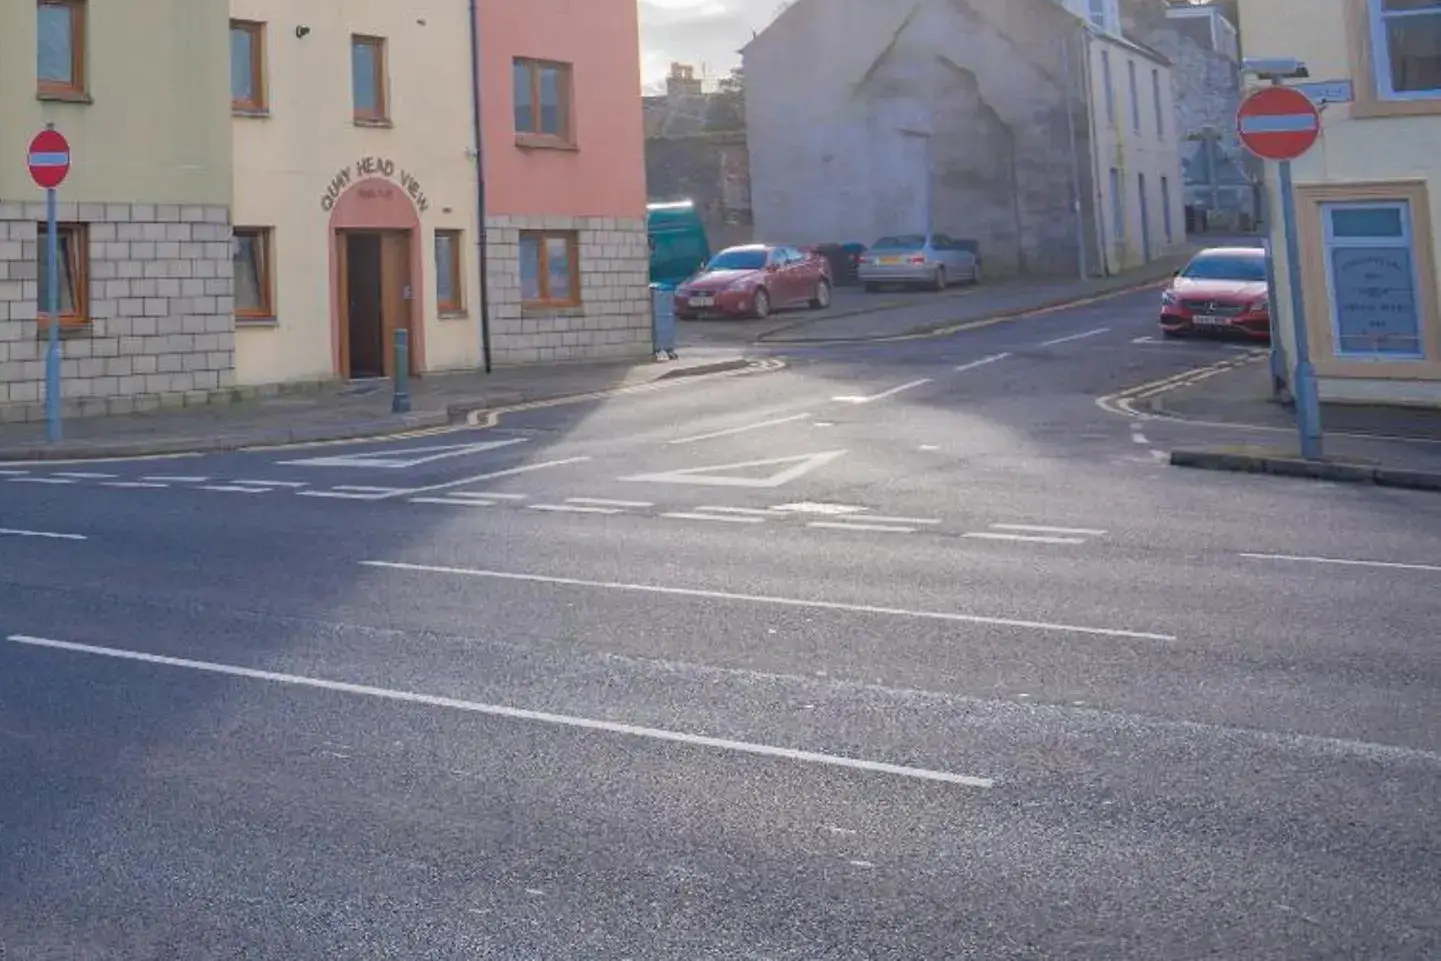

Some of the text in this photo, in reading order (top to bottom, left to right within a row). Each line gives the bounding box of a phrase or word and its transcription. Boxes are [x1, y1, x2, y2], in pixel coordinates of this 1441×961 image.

[320, 156, 429, 212] QUAY HEAD VIEW
